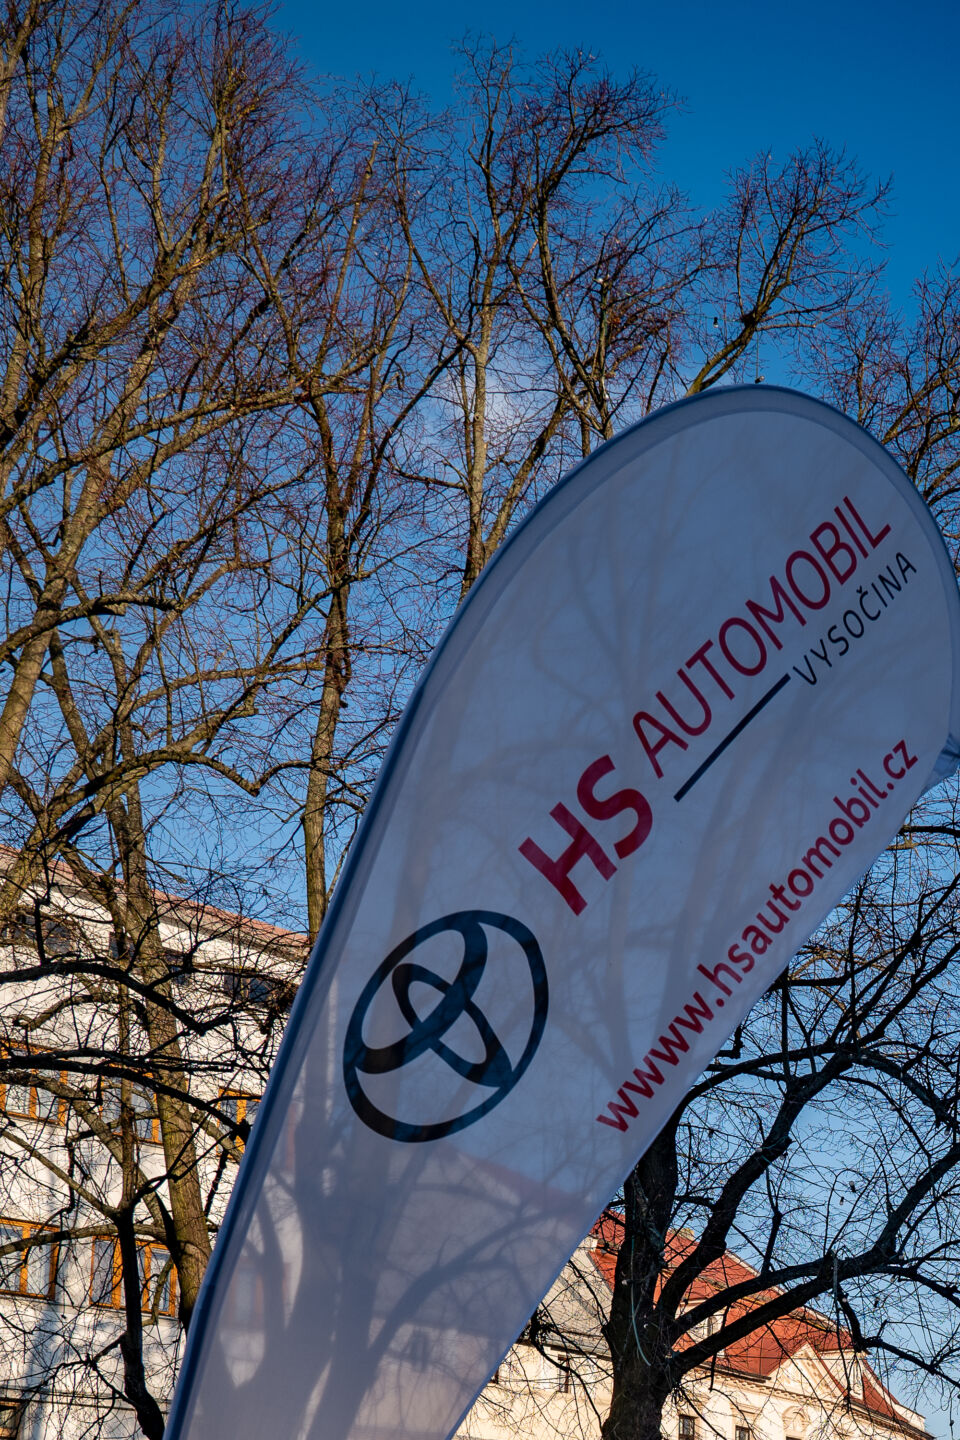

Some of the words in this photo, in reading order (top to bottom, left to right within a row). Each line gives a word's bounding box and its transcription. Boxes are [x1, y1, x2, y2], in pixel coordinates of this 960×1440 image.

[518, 755, 653, 916] HS
[632, 497, 891, 779] AUTOMOBIL
[793, 551, 917, 686] VYSOČINA
[597, 739, 918, 1133] www.hsautomobil.cz
